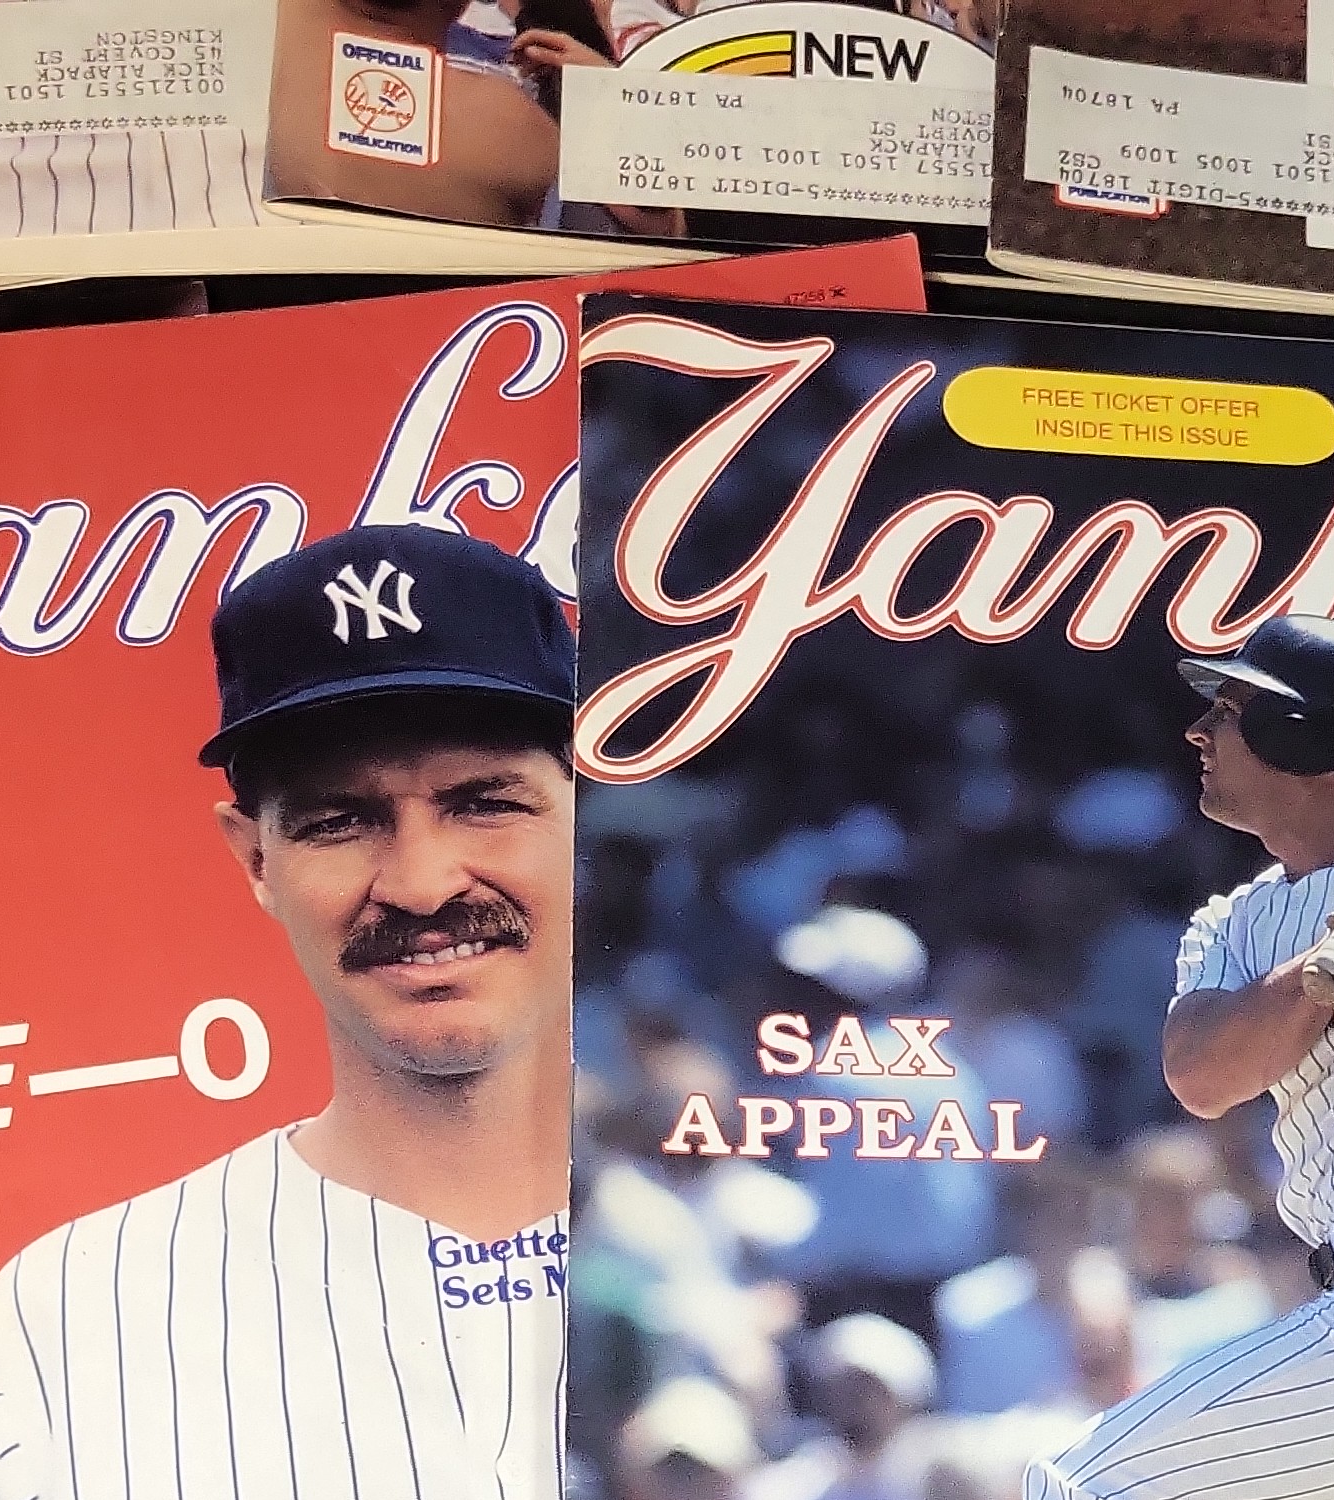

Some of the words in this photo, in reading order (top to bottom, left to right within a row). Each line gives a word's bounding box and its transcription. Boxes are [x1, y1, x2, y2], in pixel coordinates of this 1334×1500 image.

[35, 50, 63, 65] ST
[194, 45, 221, 60] 45
[342, 42, 425, 72] OFFICIAL
[803, 31, 929, 83] NEW
[37, 63, 144, 82] ALAPACK
[163, 62, 224, 78] NICK
[5, 83, 66, 101] 1501
[85, 78, 224, 97] 001215557
[622, 88, 697, 107] 18704
[1062, 85, 1133, 110] 18704
[715, 94, 743, 108] PA
[1151, 98, 1180, 115] PA
[870, 121, 896, 136] ST
[338, 131, 423, 156] PUBLICATION
[684, 143, 744, 162] 1009
[869, 137, 976, 158] ALAPACK
[762, 147, 820, 166] 1001
[841, 152, 899, 171] 1501
[1120, 144, 1178, 164] 1009
[1197, 153, 1253, 174] 1005
[619, 173, 696, 192] 18704
[1059, 167, 1132, 190] 18704
[1272, 163, 1331, 183] 1501
[1023, 387, 1084, 407] FREE
[1091, 390, 1173, 413] TICKET
[1180, 396, 1260, 418] OFFER
[1036, 419, 1113, 440] INSIDE
[1120, 423, 1173, 443] THIS
[1181, 427, 1249, 447] ISSUE
[323, 559, 421, 645] NY
[755, 1011, 957, 1078] SAX
[663, 1093, 1049, 1163] APPEAL
[428, 1229, 568, 1268] Guette
[442, 1274, 533, 1309] Sets
